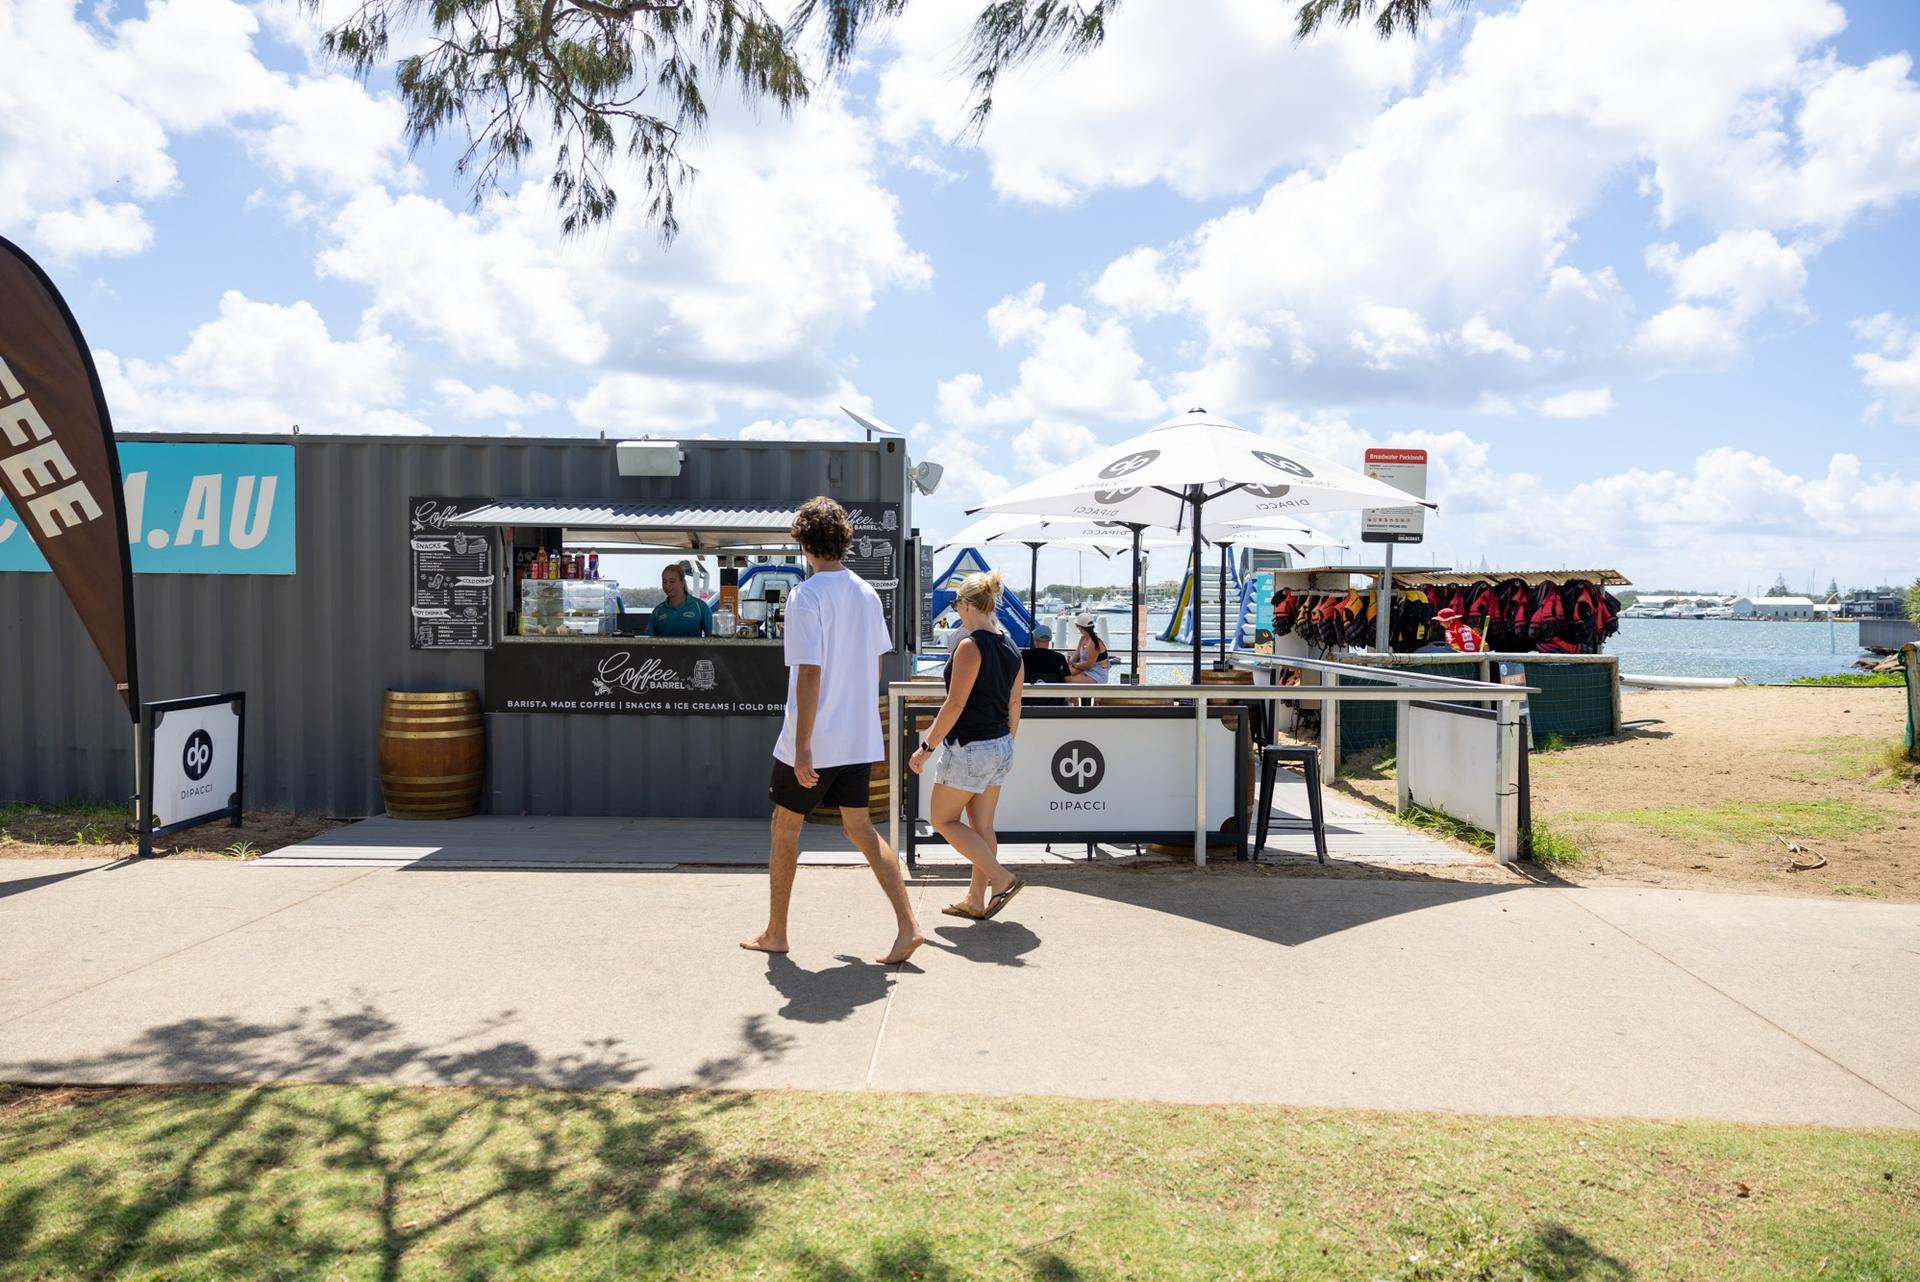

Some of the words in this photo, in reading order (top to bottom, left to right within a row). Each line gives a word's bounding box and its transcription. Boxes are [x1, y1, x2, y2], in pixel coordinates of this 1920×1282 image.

[0, 356, 103, 538] FEE
[123, 471, 279, 549] .AU
[597, 651, 678, 693] Coffee
[650, 681, 685, 690] BARREL
[507, 700, 547, 708] BARISTA
[550, 701, 577, 709] MADE
[579, 701, 616, 709] COFFEE
[625, 702, 662, 710] SNACKS
[665, 702, 671, 710] &
[674, 702, 689, 710] ICE
[692, 702, 729, 711] CREAMS
[738, 703, 764, 711] COLD
[767, 703, 786, 711] DRI
[187, 737, 209, 774] dp
[1059, 748, 1098, 788] dp
[181, 784, 213, 800] DIPACCI
[1050, 801, 1106, 811] DIPACCI
